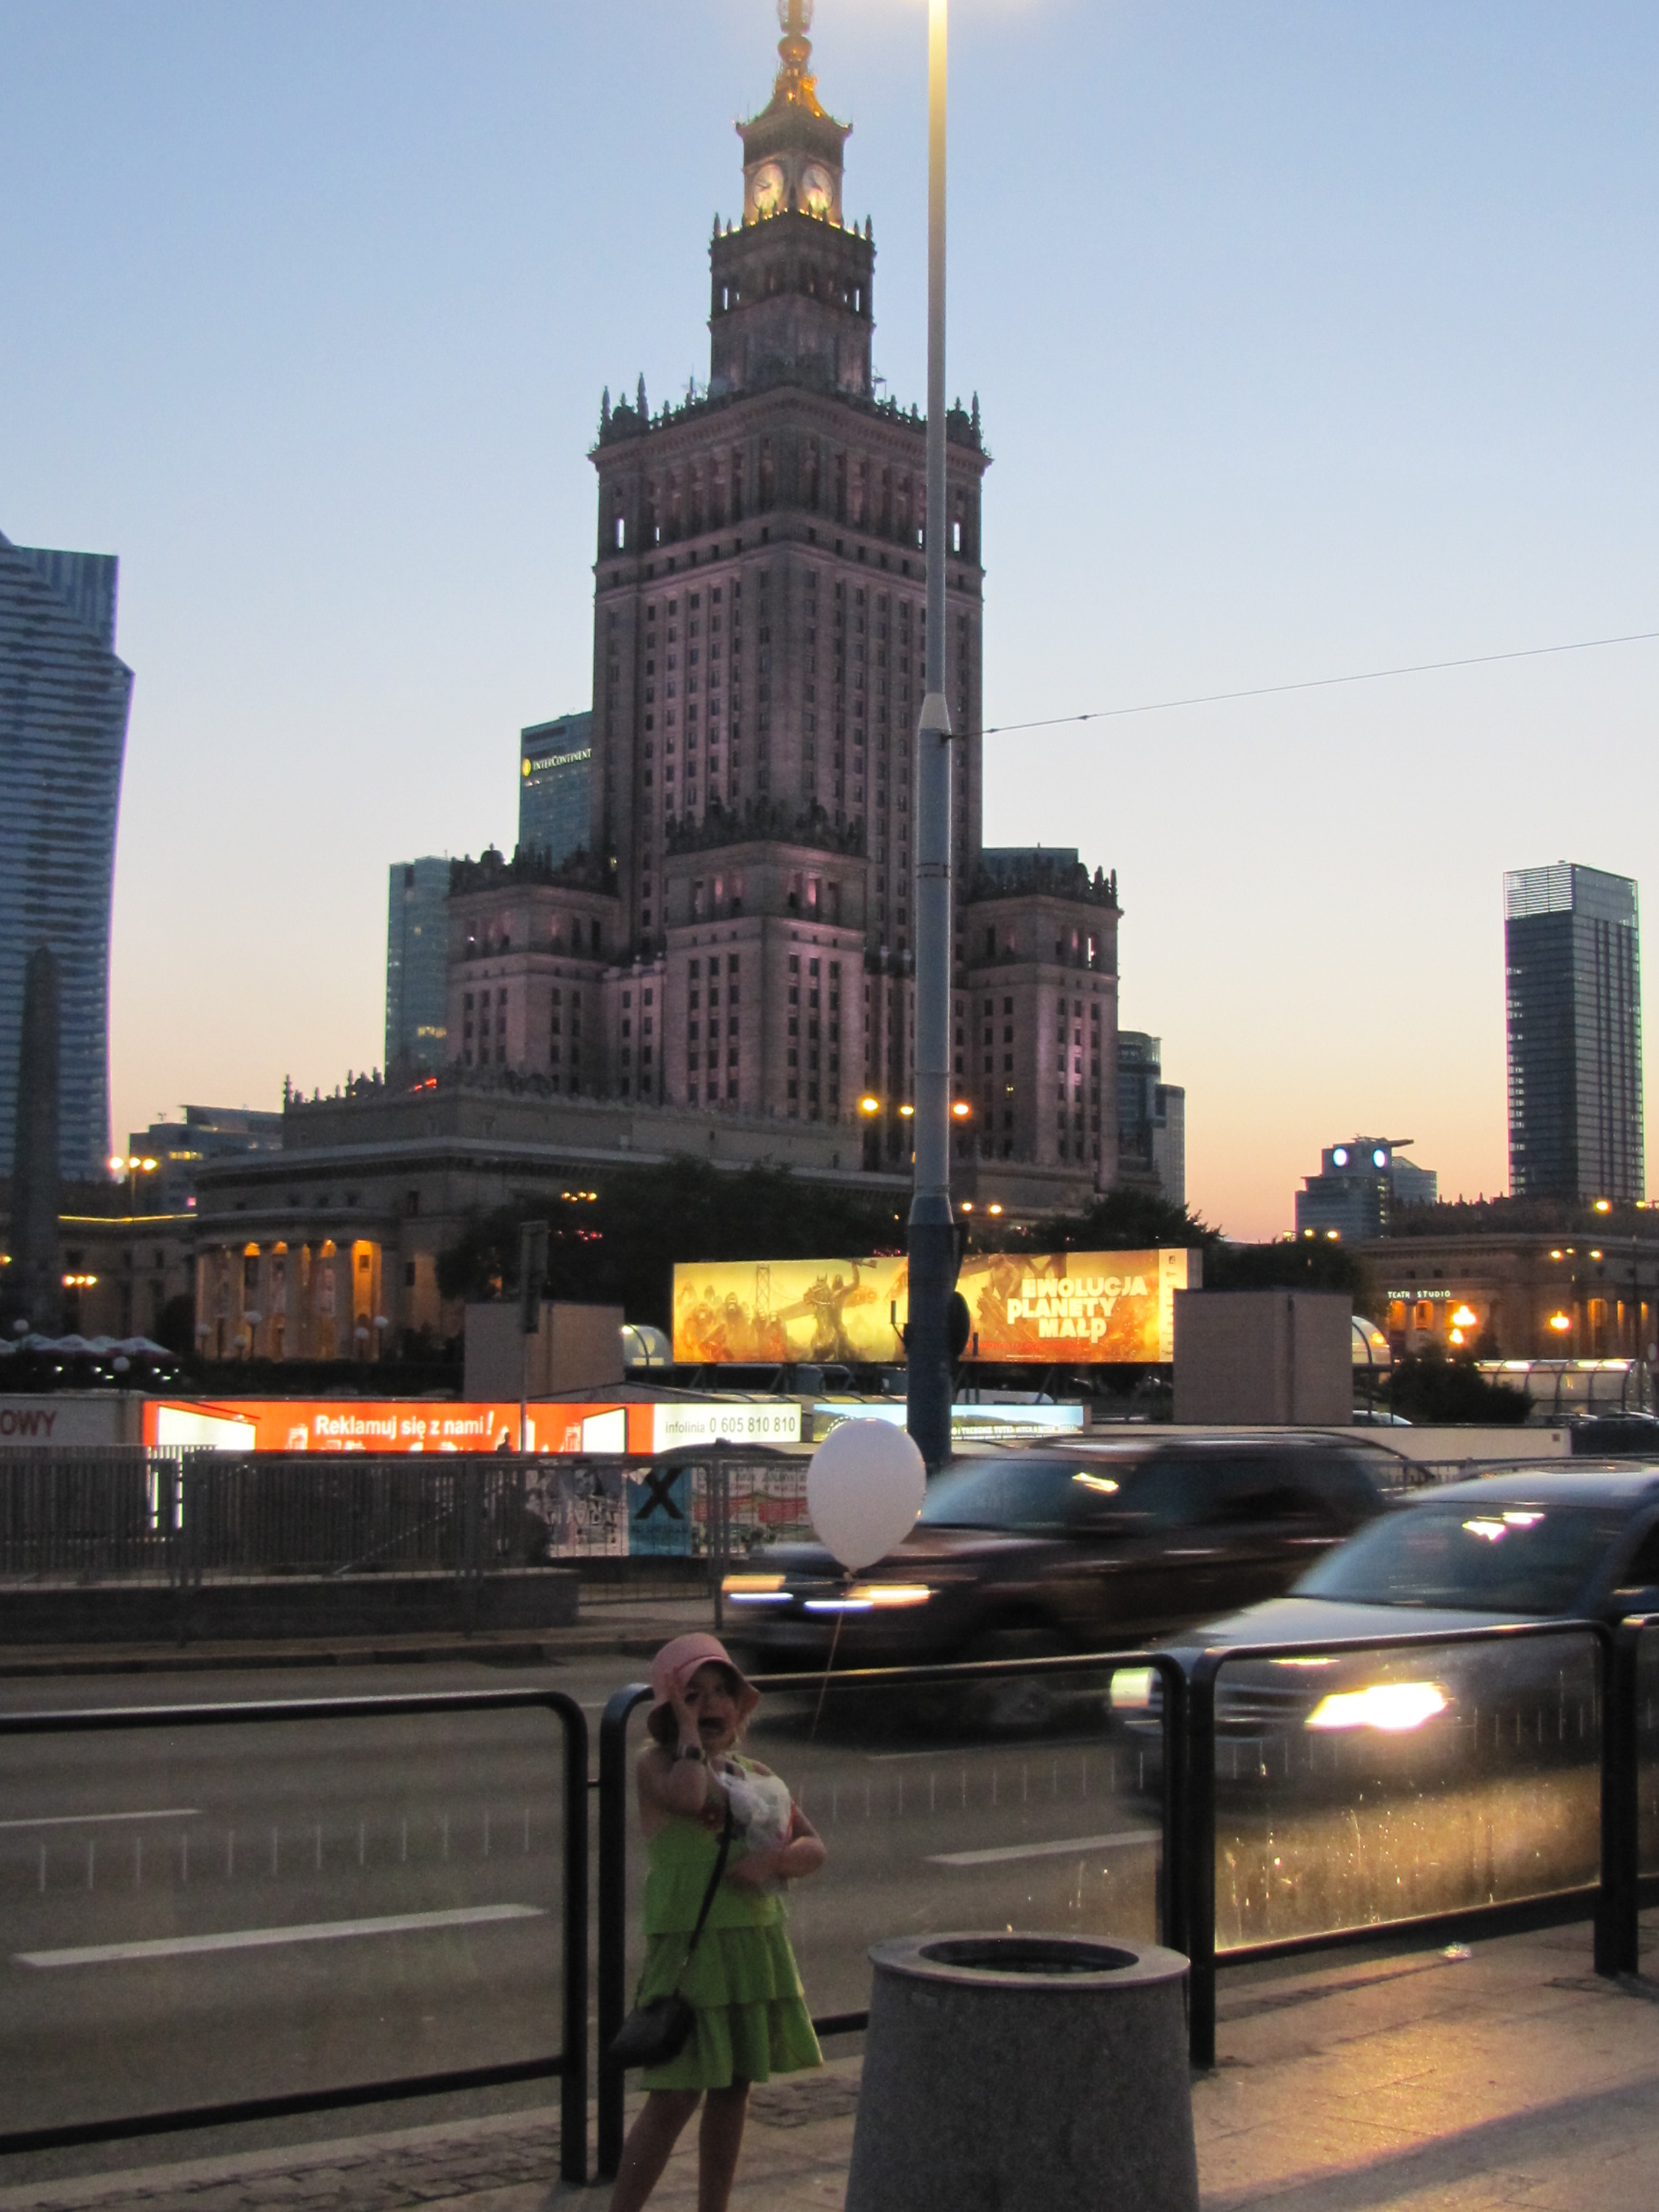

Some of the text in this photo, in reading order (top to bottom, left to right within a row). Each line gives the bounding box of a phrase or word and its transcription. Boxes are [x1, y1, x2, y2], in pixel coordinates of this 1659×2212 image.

[1021, 1276, 1148, 1298] EWOLUCJA
[1387, 1290, 1451, 1298] TEATR STUDIO
[1007, 1297, 1117, 1324] PLANETY
[1038, 1317, 1107, 1344] MAŁP
[316, 1414, 396, 1439] Reklamuj
[401, 1415, 426, 1439] się
[430, 1420, 440, 1435] z
[665, 1416, 795, 1433] infolinia 0 605 810 810
